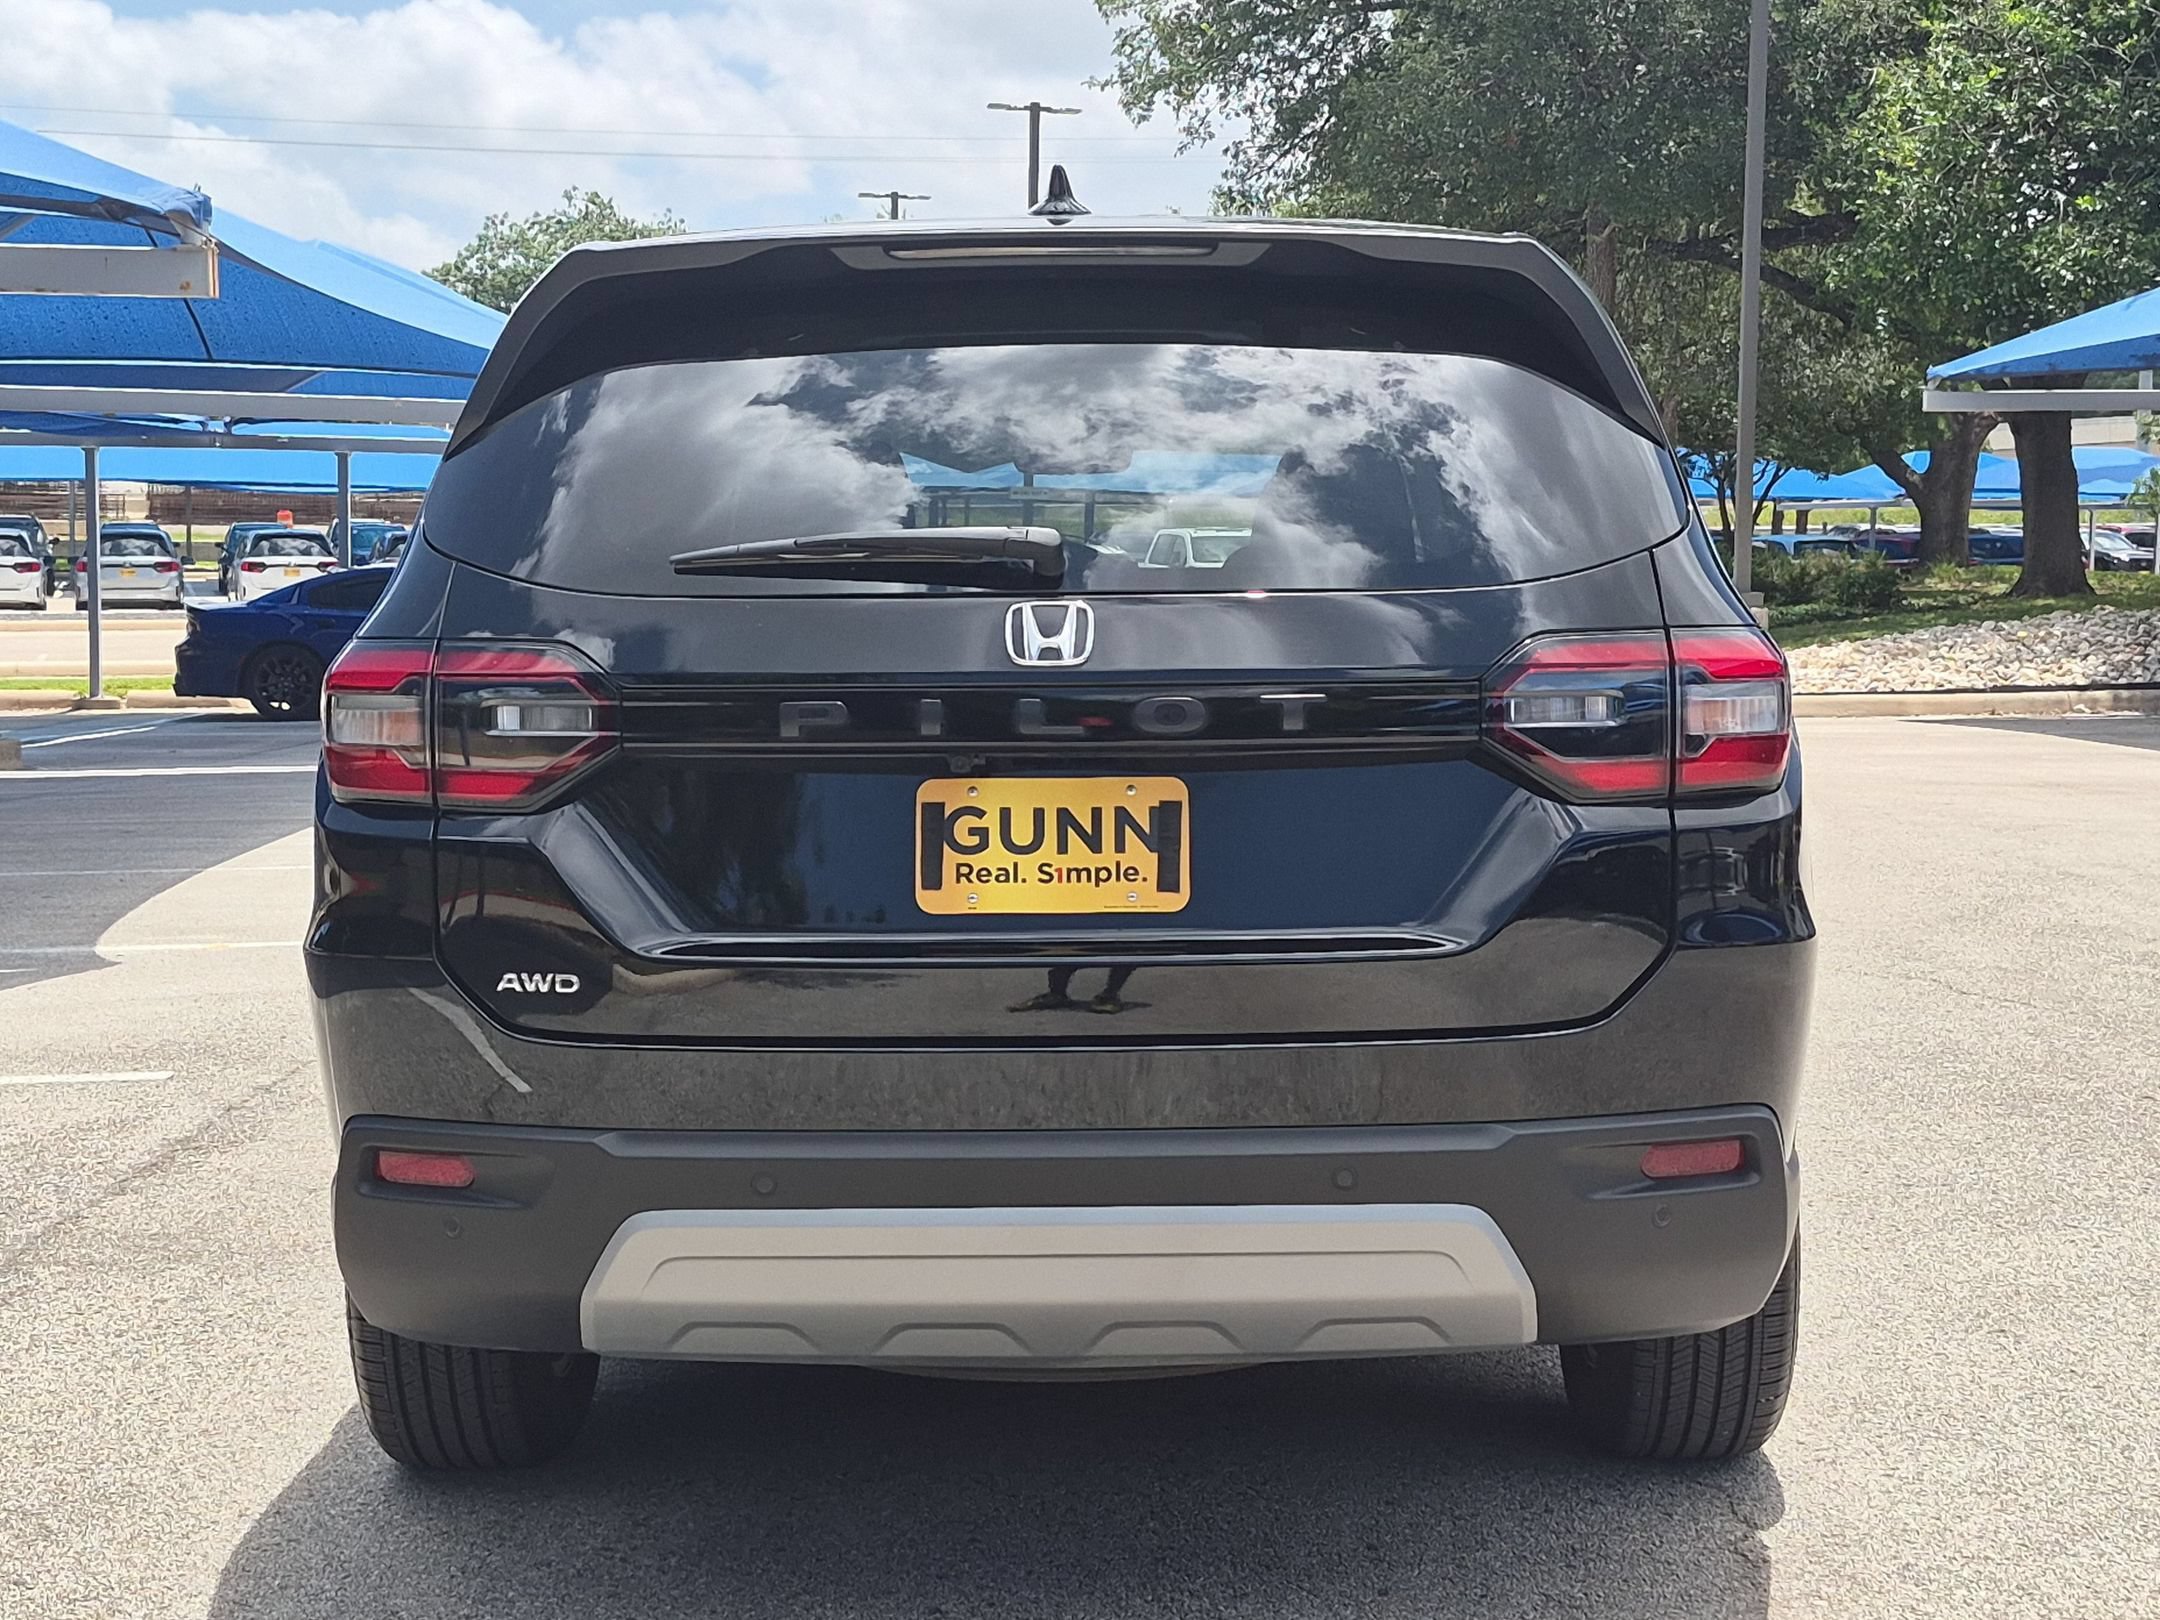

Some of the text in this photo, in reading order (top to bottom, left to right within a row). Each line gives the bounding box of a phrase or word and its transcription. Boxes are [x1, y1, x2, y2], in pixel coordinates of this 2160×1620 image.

[779, 693, 1327, 737] PILOT
[943, 805, 1160, 855] GUNN
[955, 861, 1027, 884] Real.
[495, 972, 581, 993] AWD
